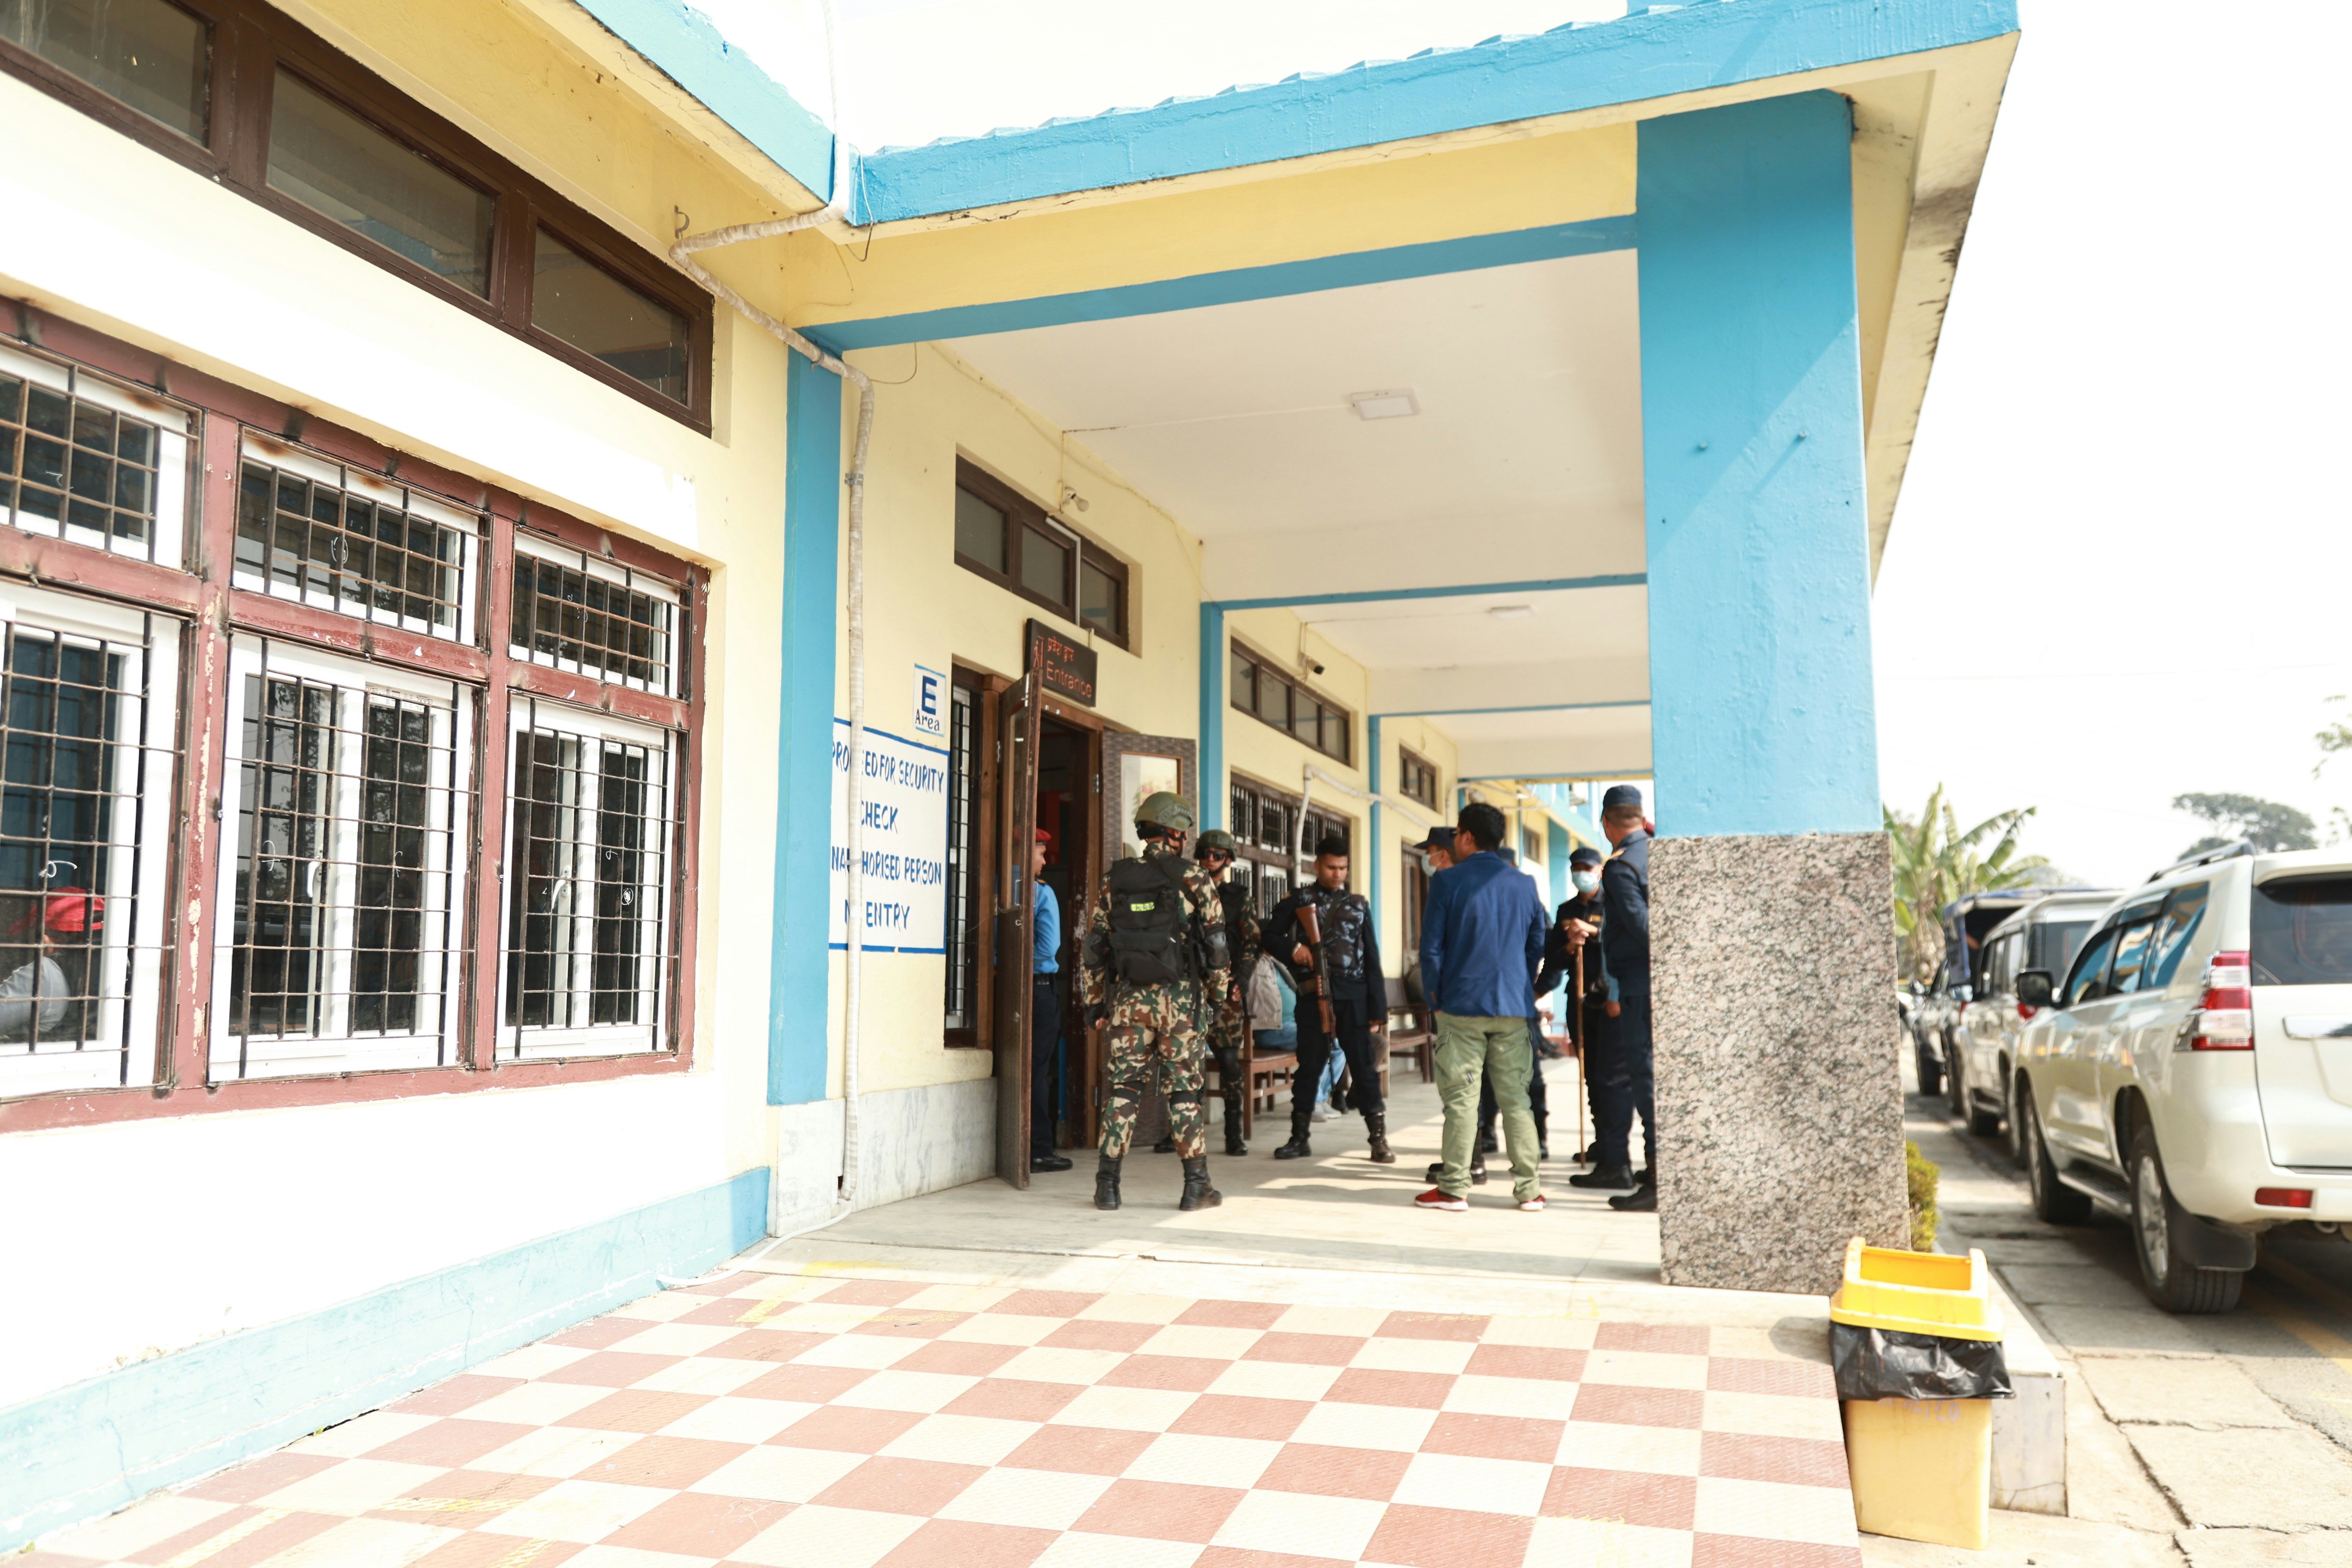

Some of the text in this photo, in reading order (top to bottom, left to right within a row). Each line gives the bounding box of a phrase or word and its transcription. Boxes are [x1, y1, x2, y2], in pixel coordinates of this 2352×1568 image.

[922, 675, 937, 715] E
[1046, 660, 1092, 698] Entrance
[915, 709, 940, 731] Area
[833, 741, 944, 794] PROED FOR SECURITY
[831, 846, 942, 886] NAHORISED PERSON
[866, 901, 910, 932] ENTRY
